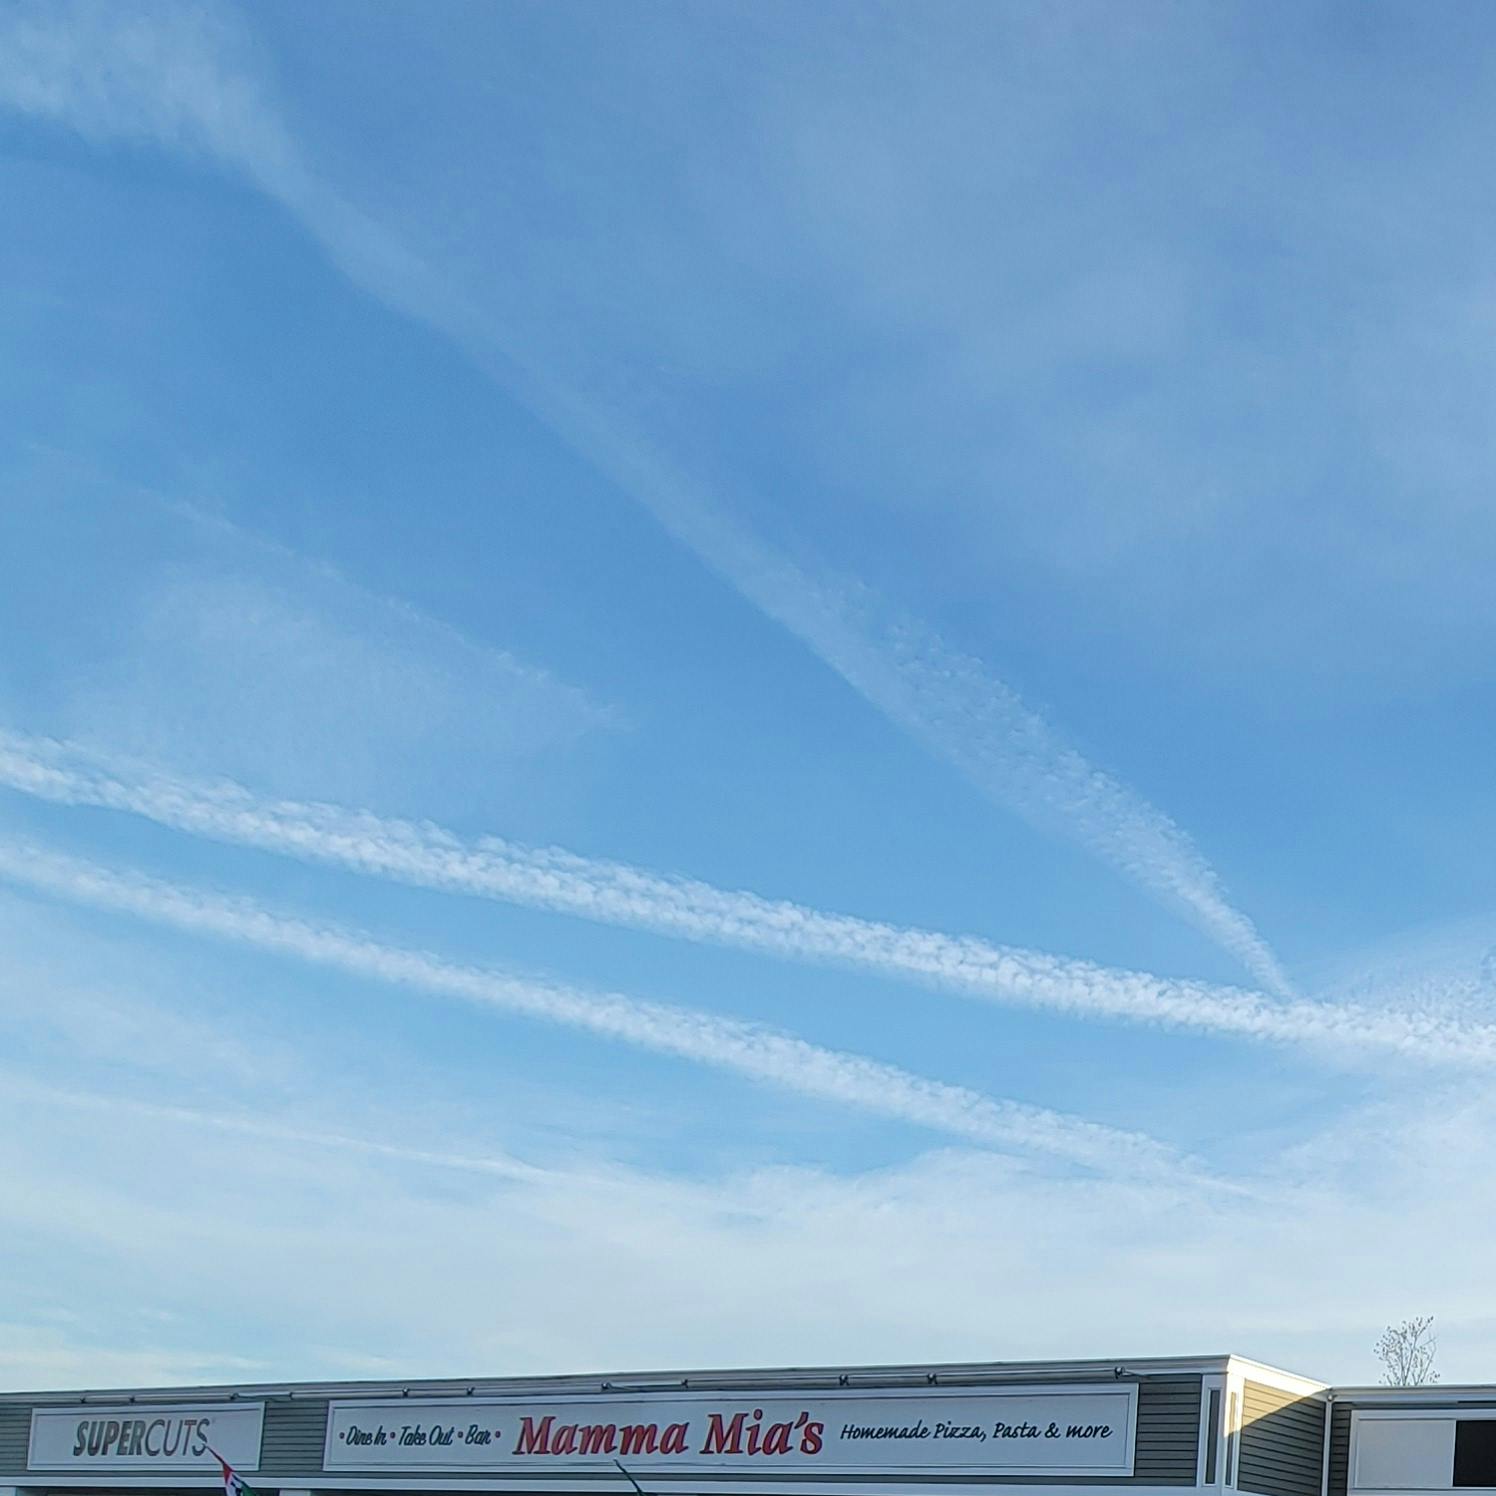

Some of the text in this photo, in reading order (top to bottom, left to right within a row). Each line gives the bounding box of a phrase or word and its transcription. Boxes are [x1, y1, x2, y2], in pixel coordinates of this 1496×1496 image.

[73, 1418, 210, 1457] SUPERCUTS
[346, 1424, 492, 1446] Dine In Take Out Bar
[512, 1408, 825, 1456] Mamma Mia's
[840, 1420, 1114, 1442] Homemade Pizza, Pasta & more
